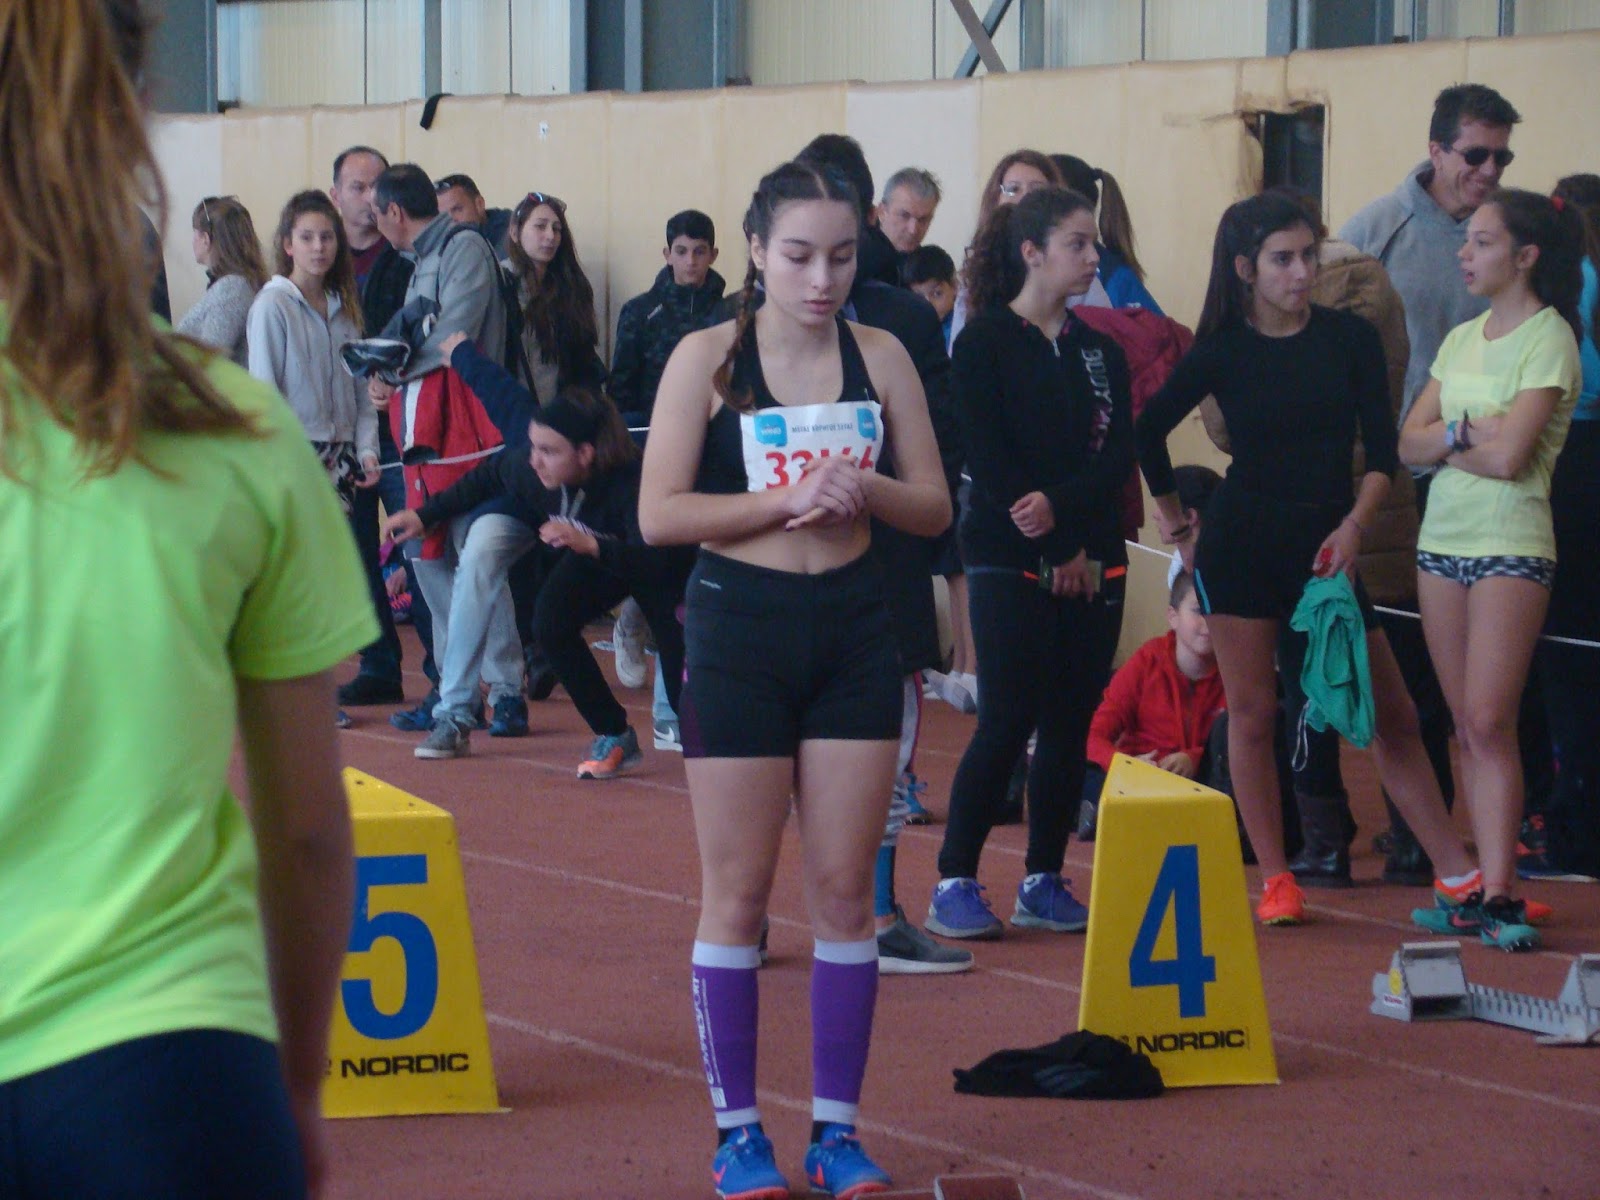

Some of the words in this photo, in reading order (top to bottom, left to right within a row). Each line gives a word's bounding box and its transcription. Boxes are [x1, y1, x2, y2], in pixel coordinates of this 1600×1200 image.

[341, 854, 439, 1040] 5
[1129, 844, 1216, 1018] 4
[341, 1052, 470, 1079] NORDIC
[1136, 1029, 1245, 1054] NORDIC
